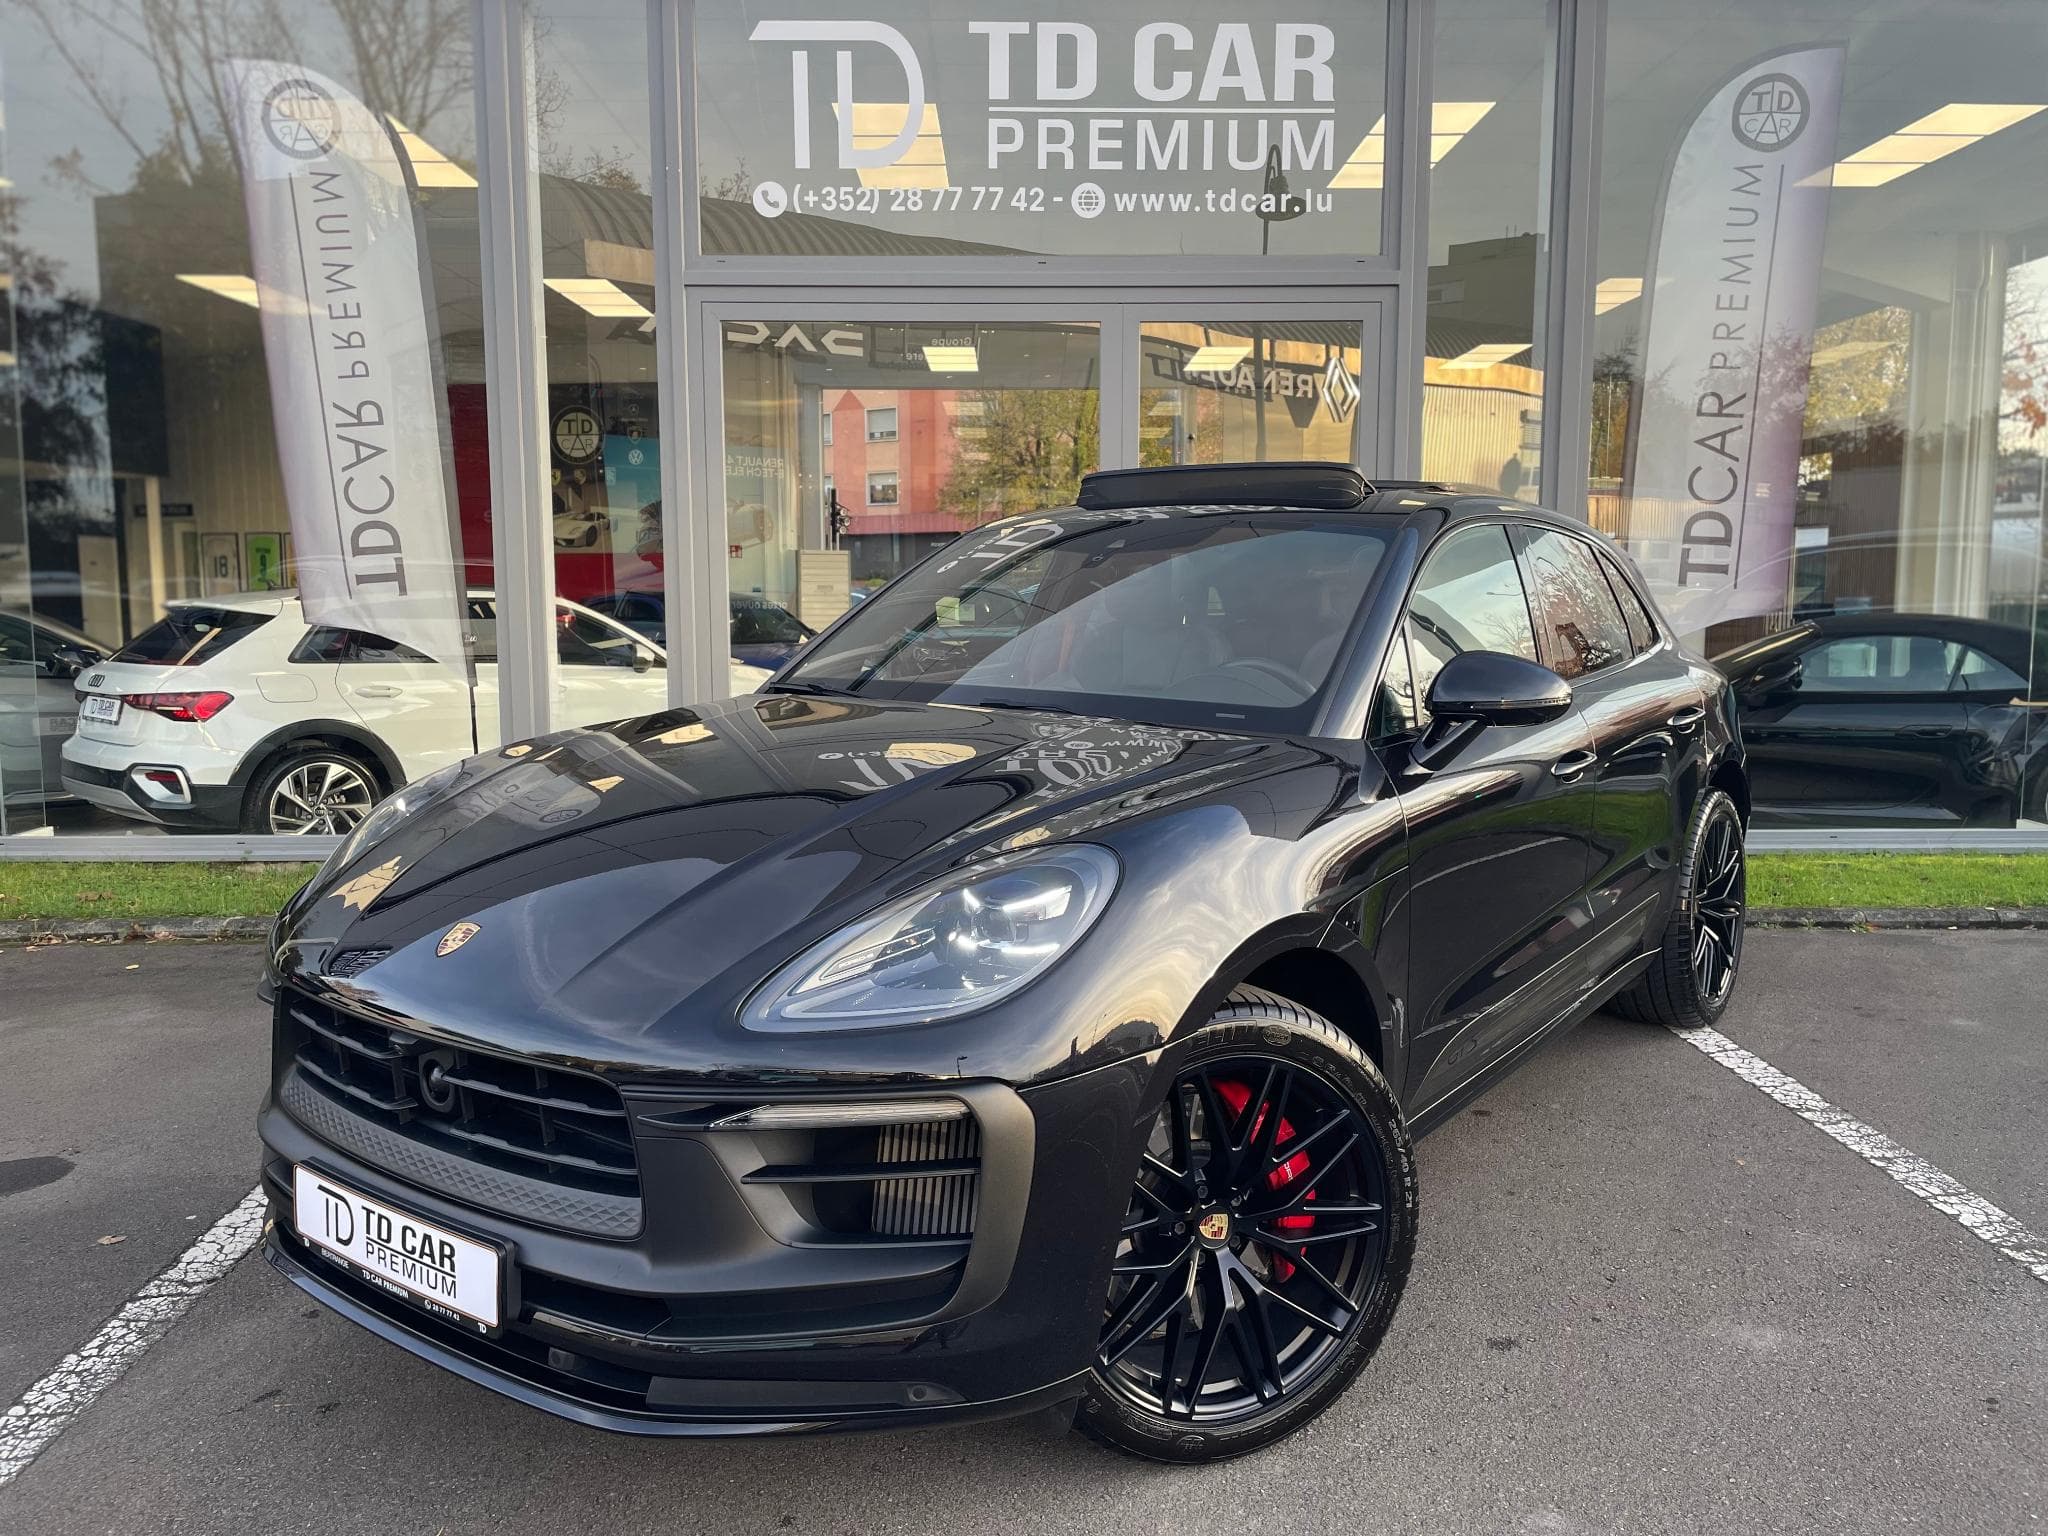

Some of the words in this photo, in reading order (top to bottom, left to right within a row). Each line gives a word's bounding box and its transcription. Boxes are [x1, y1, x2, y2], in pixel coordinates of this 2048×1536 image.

[968, 21, 1098, 102] TD
[1133, 20, 1335, 102] CAR
[1751, 90, 1794, 111] TD
[1744, 114, 1792, 142] CAR
[988, 118, 1335, 171] PREMIUM
[792, 187, 879, 215] (+352)
[890, 187, 923, 212] 28
[930, 187, 962, 212] 77
[970, 187, 1003, 212] 77
[1010, 187, 1046, 213] 42
[1113, 187, 1333, 213] www.tdcar.lu
[1709, 163, 1764, 370] PREMIUM
[563, 418, 593, 434] TD
[561, 436, 594, 456] CAR
[214, 555, 228, 577] 18
[1403, 1176, 1412, 1188] R
[1405, 1191, 1413, 1208] 21
[361, 1205, 392, 1244] TD
[401, 1224, 456, 1273] CAR
[366, 1241, 457, 1299] PREMIUM
[362, 1269, 371, 1280] TD
[371, 1274, 382, 1287] CAR
[383, 1279, 409, 1300] PREMIUM
